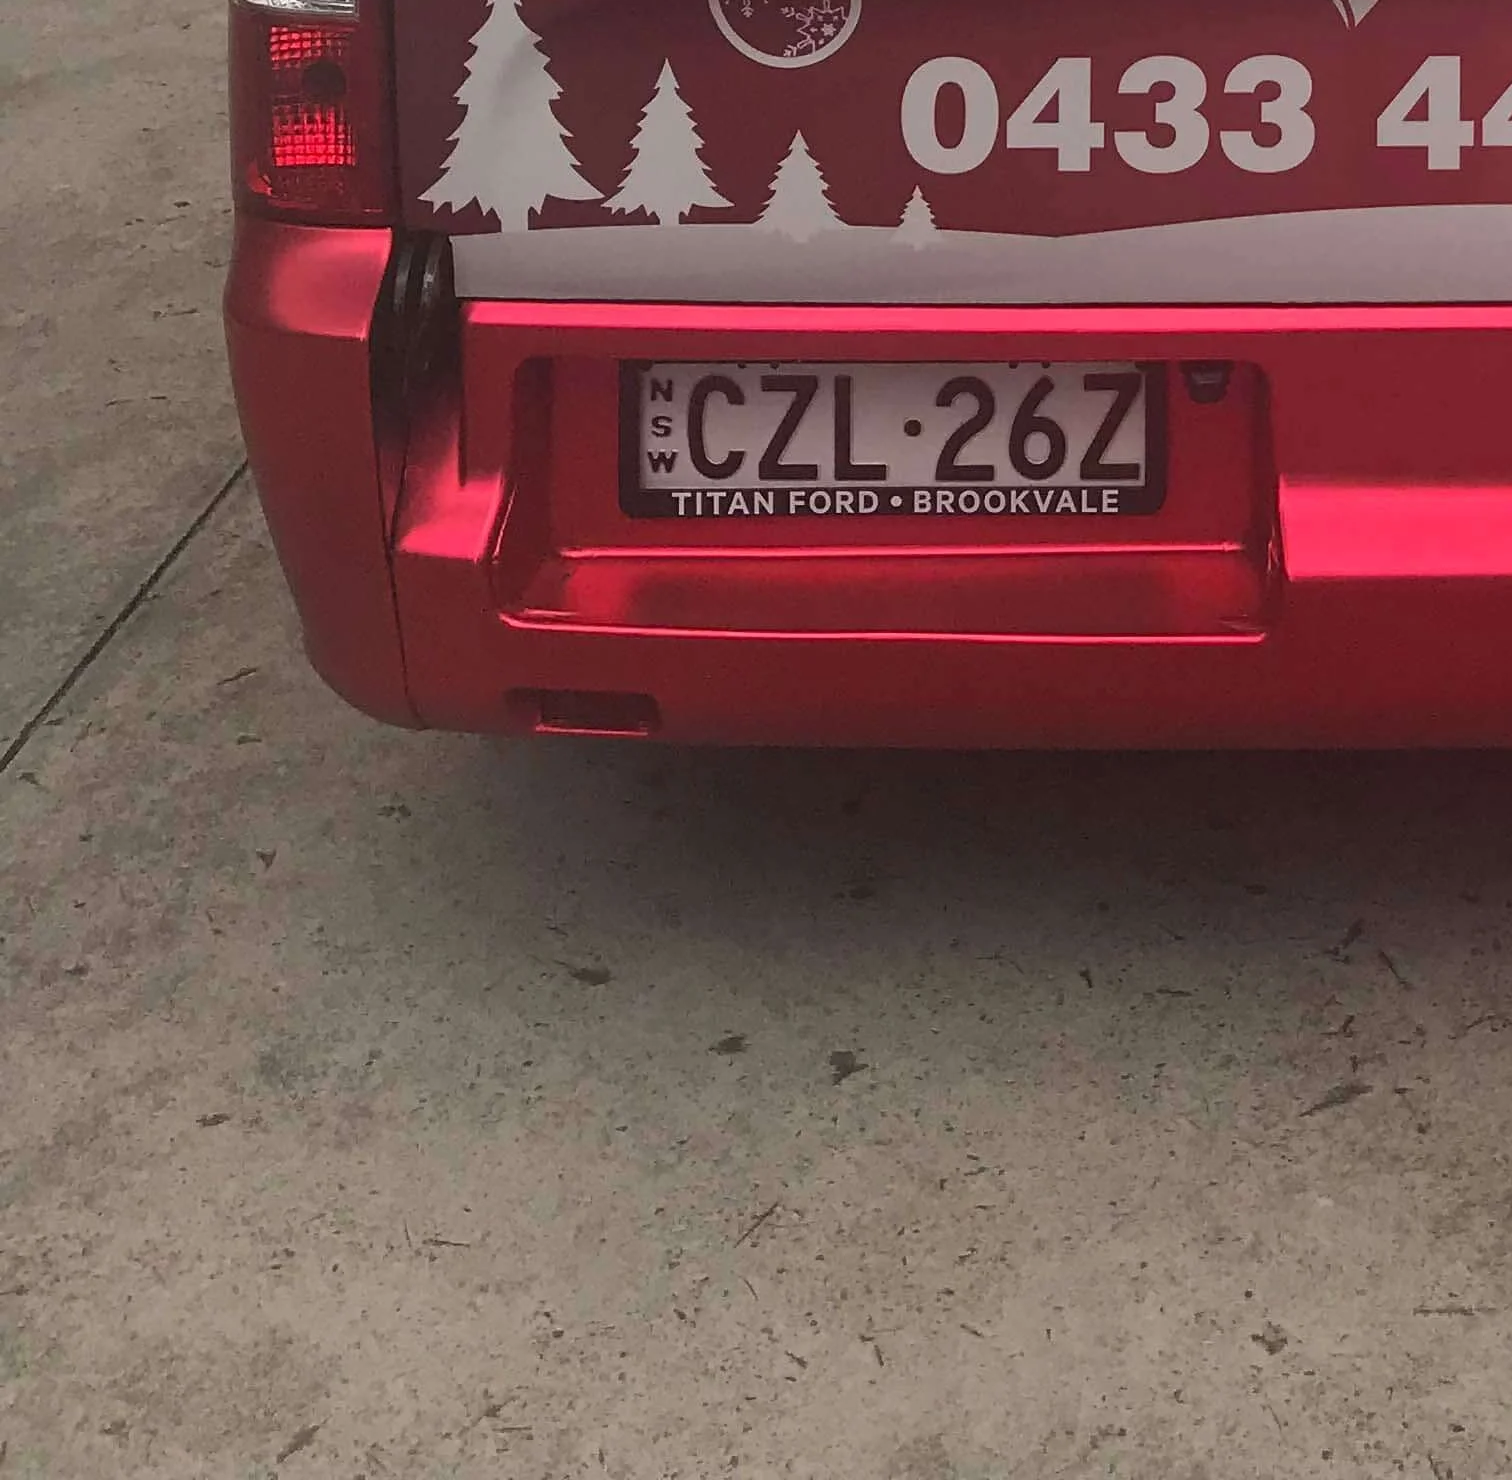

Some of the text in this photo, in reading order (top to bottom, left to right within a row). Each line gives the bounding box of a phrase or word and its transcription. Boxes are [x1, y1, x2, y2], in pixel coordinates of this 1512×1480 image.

[902, 55, 1316, 174] 0433
[672, 489, 1119, 516] TITAN FORD BROOKVALE
